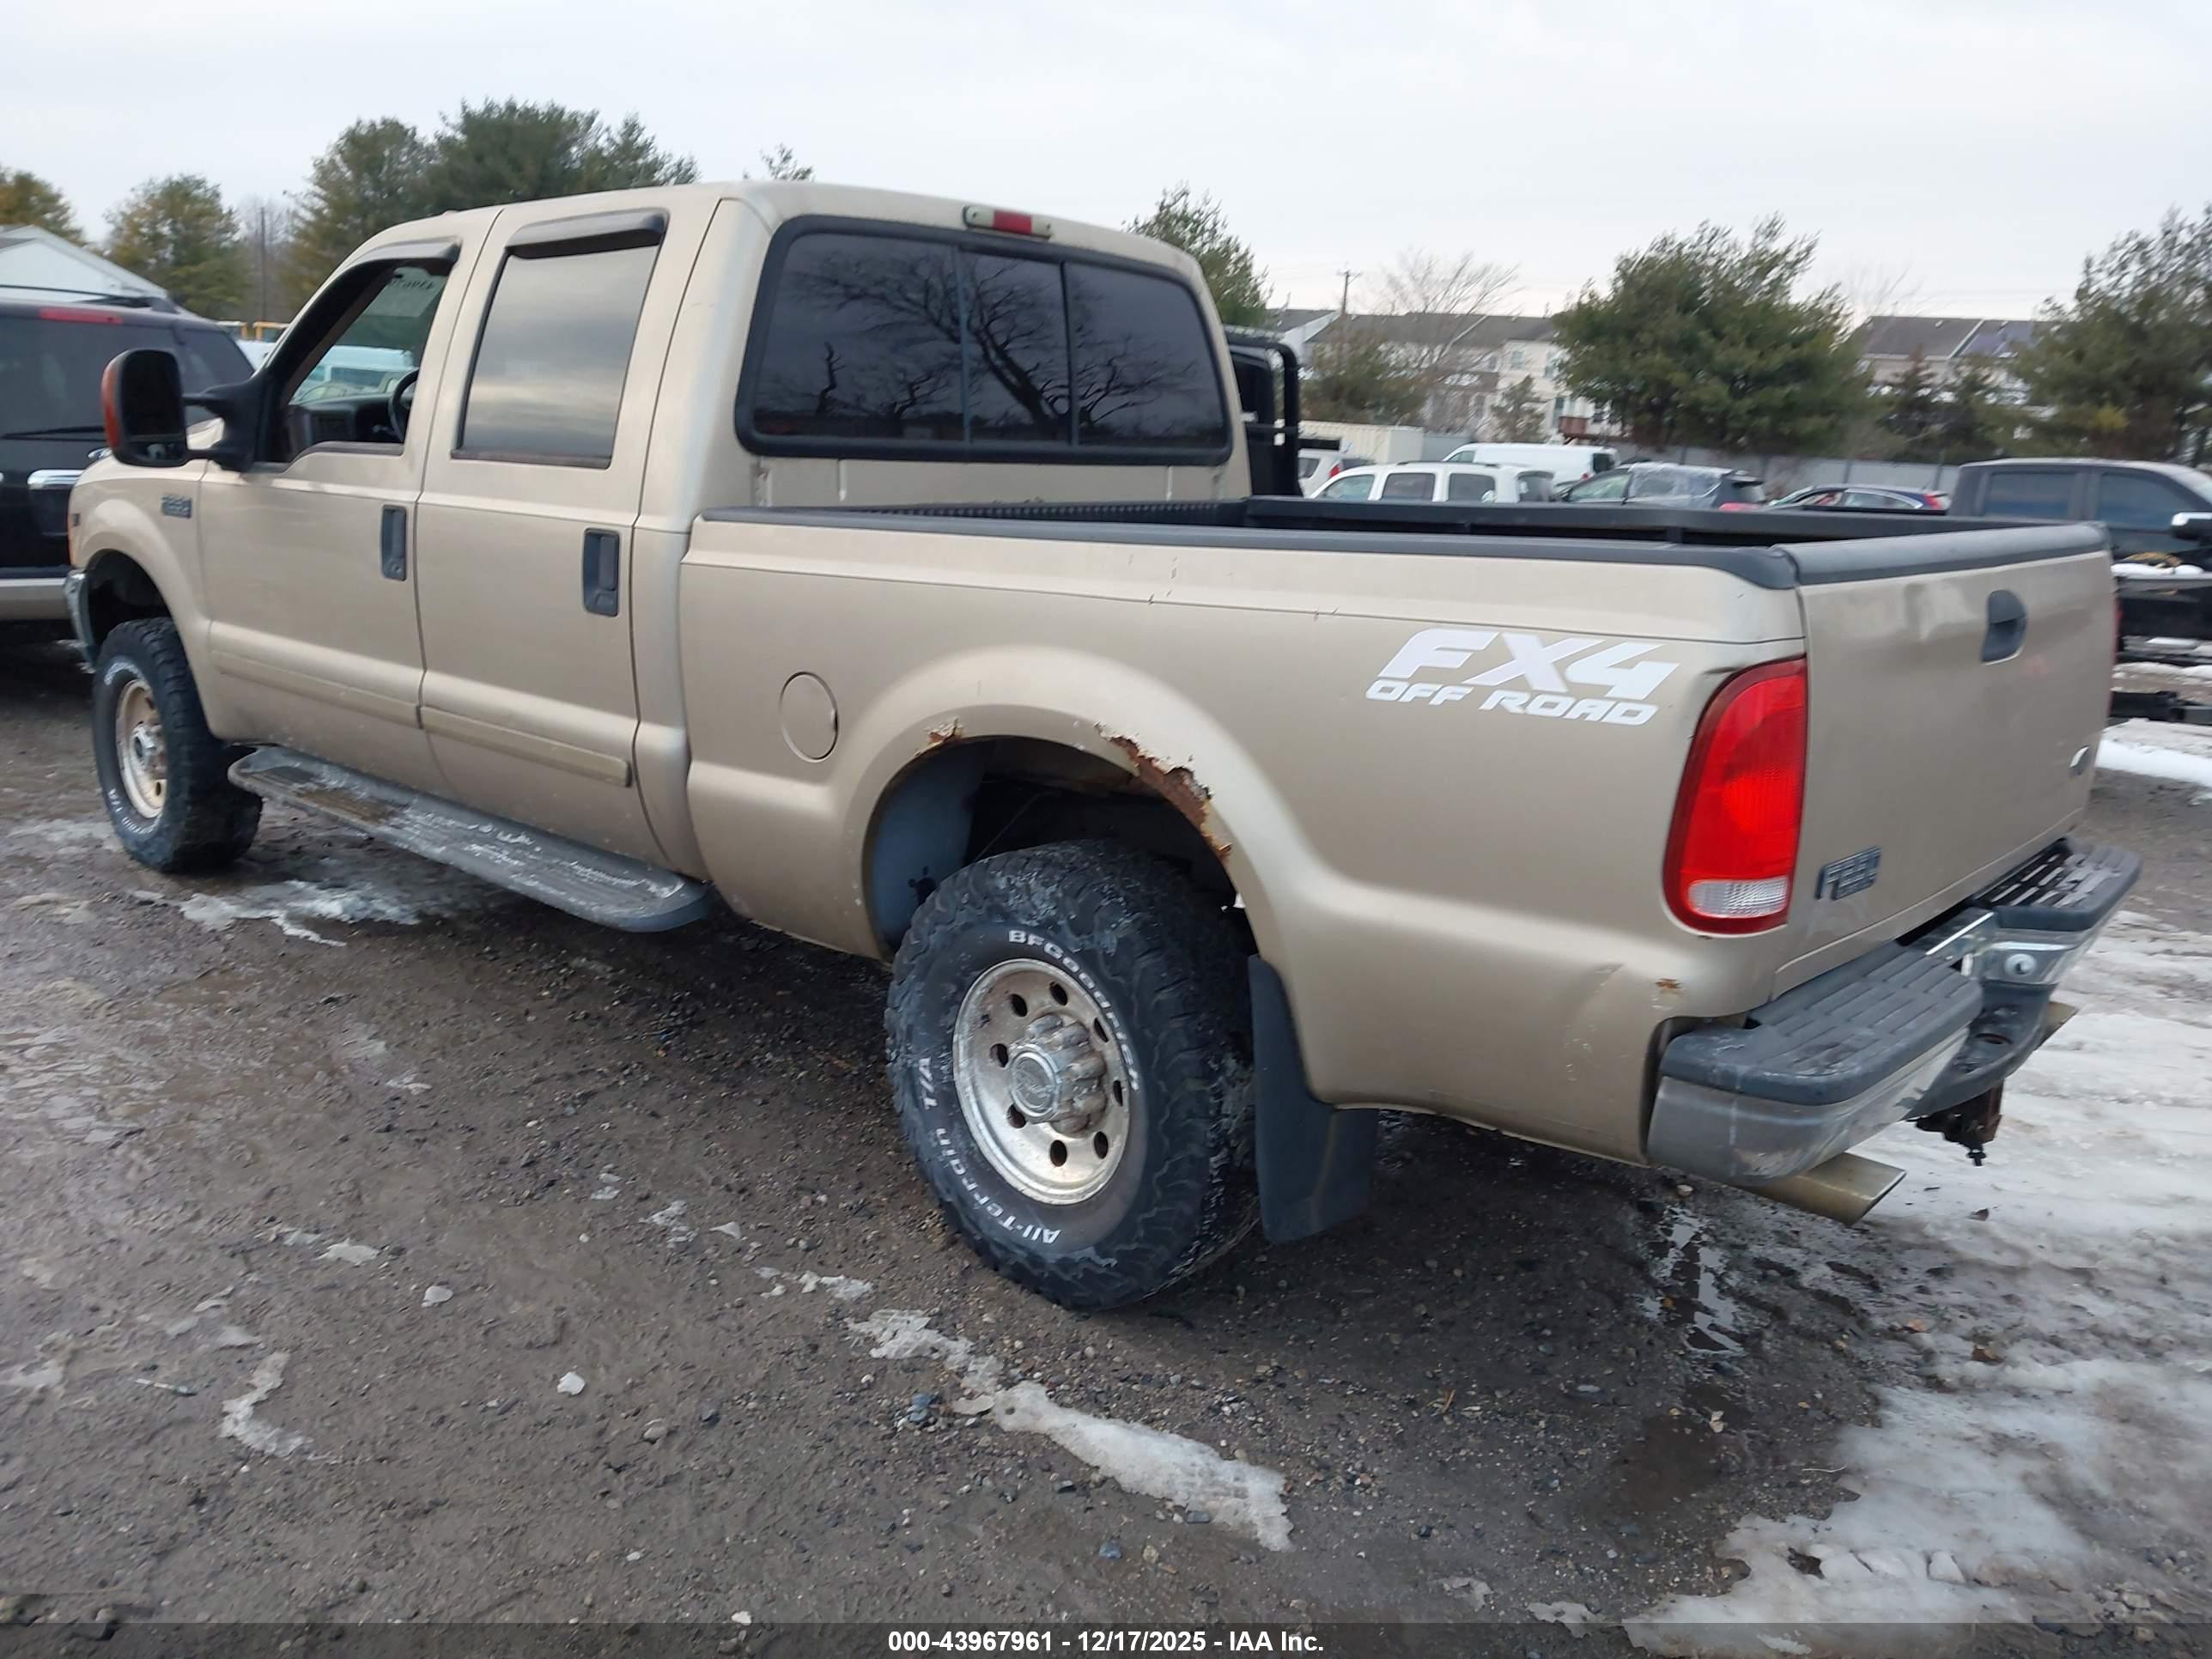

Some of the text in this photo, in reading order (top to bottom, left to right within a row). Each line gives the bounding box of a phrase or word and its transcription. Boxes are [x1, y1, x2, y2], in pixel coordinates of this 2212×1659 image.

[1376, 627, 1681, 701] FX4
[1365, 678, 1660, 726] OFF ROAD
[918, 1056, 938, 1110] T/A
